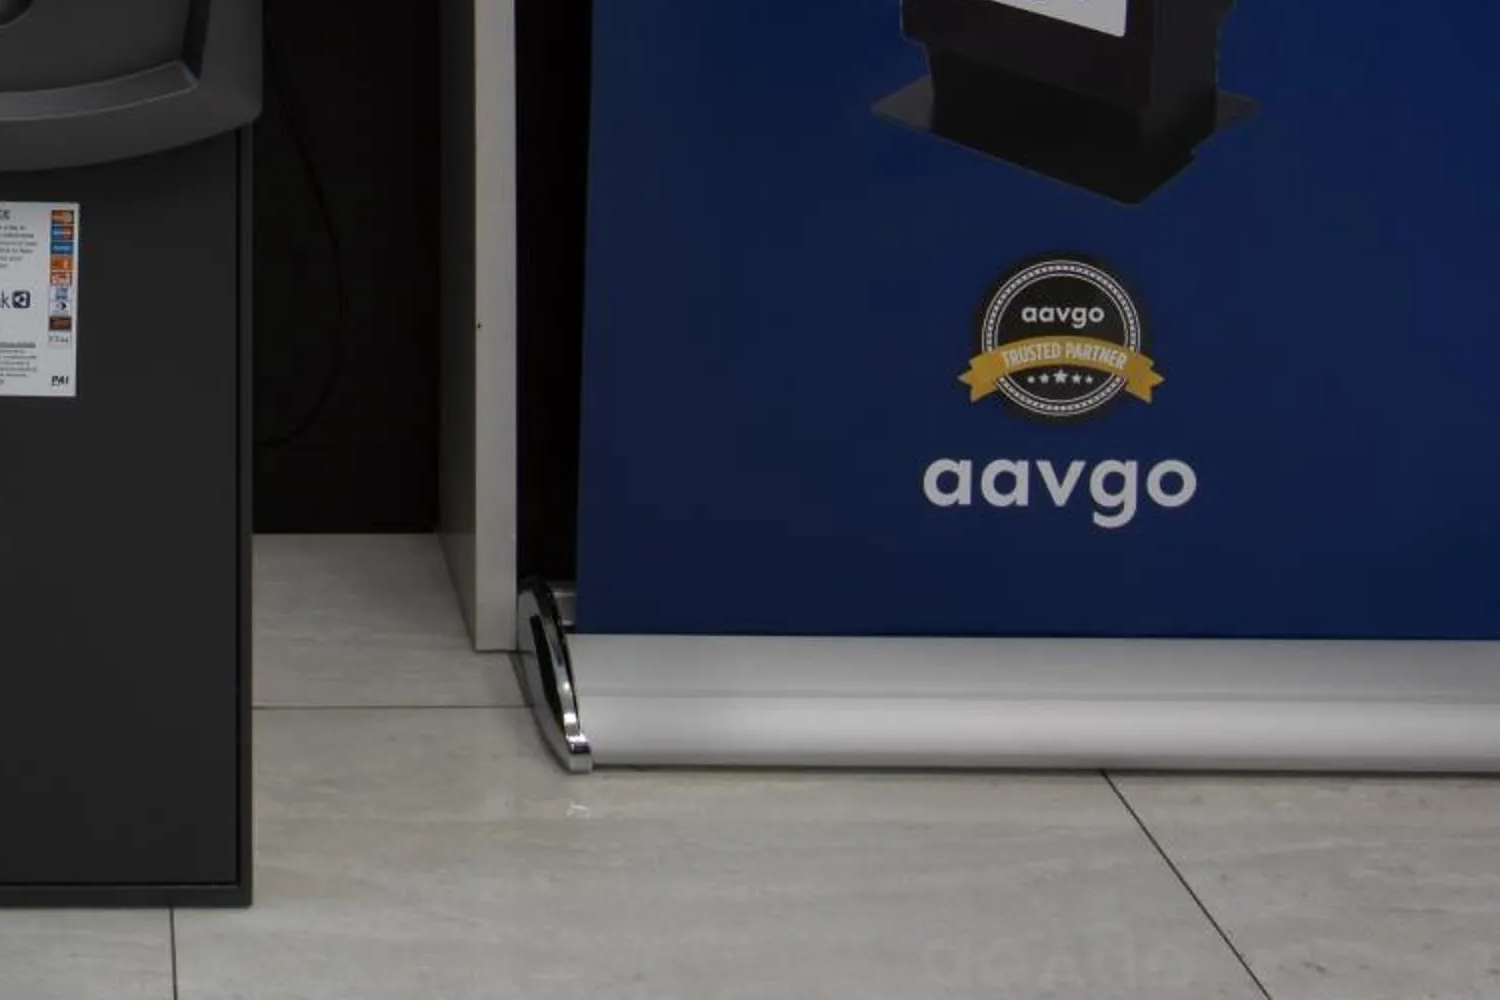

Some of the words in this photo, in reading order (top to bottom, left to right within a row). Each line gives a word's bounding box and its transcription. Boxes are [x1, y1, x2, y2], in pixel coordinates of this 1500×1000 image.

[1021, 305, 1105, 329] aavgo
[1001, 343, 1062, 369] TRUSTED
[1064, 342, 1129, 370] PARTNER
[923, 457, 1197, 528] aavgo
